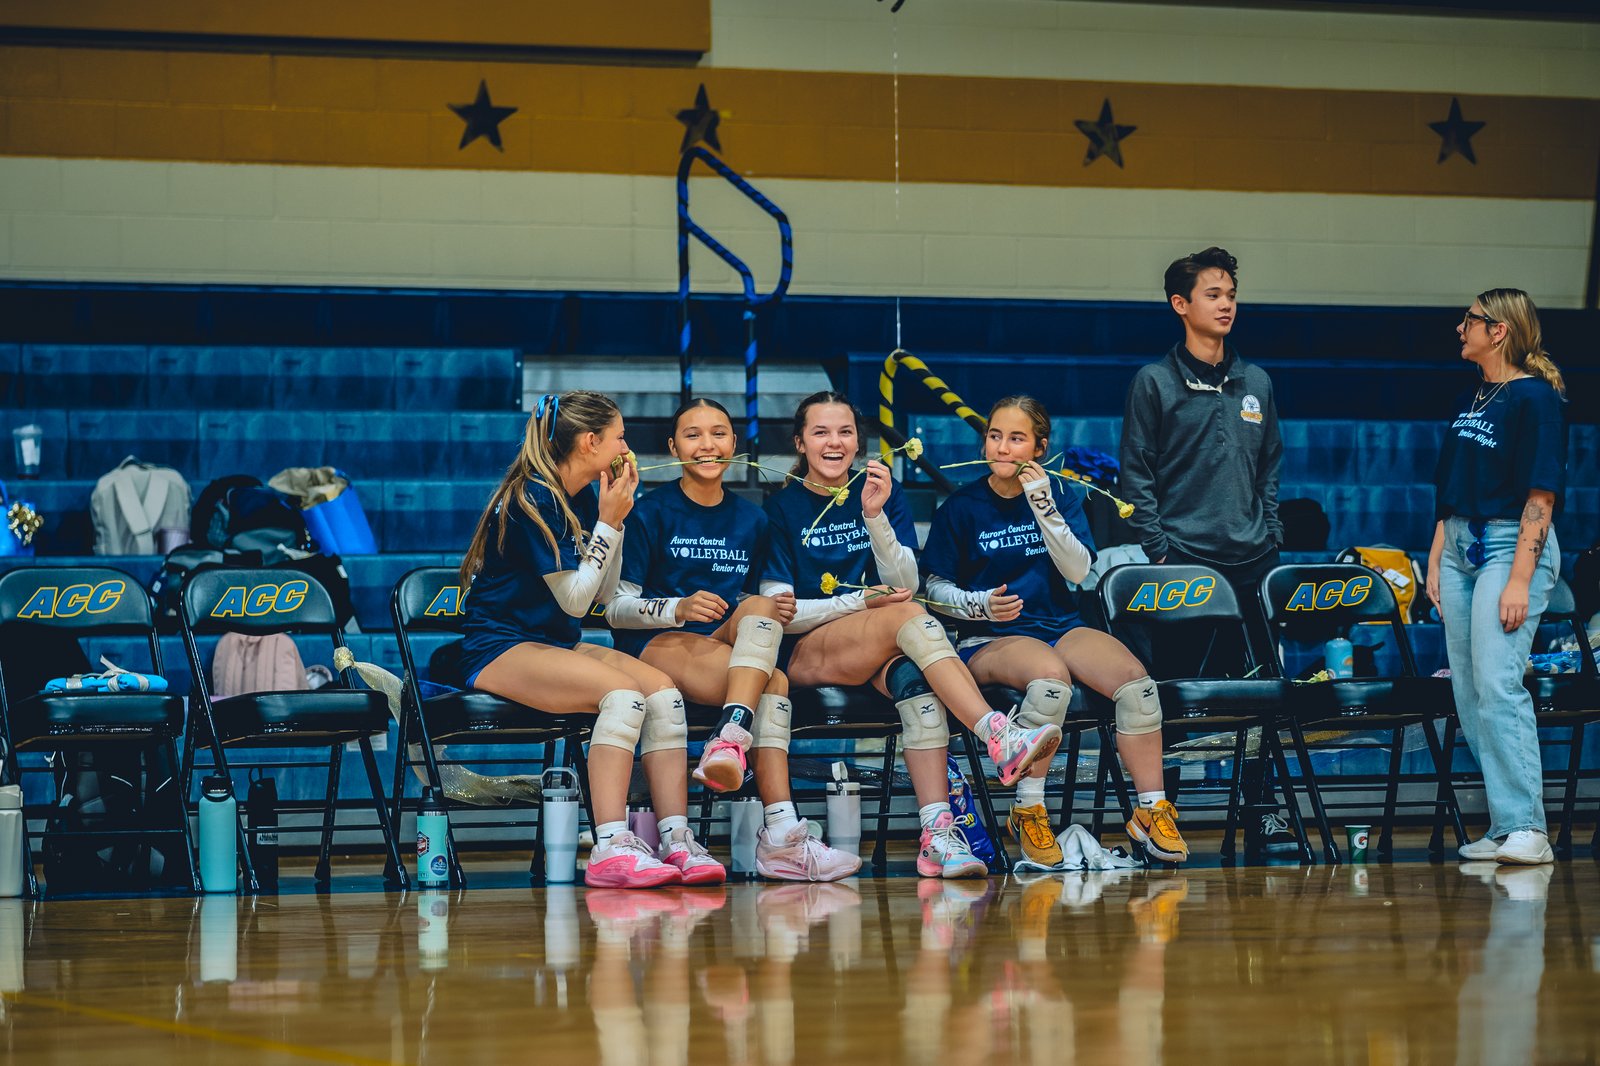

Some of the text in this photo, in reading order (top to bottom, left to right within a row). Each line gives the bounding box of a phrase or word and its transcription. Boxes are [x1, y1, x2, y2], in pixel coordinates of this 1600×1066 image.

[1474, 434, 1497, 448] Night
[829, 519, 857, 532] Central
[979, 521, 1035, 539] Aurora Central
[670, 535, 726, 546] Aurora Central
[802, 526, 869, 548] VOLLEYBA
[670, 547, 749, 561] VOLLEYBALL
[712, 562, 749, 576] Senior Nig
[17, 580, 126, 618] ACC
[210, 580, 309, 617] ACC
[1127, 575, 1216, 611] ACC
[1285, 575, 1373, 611] ACC
[1353, 832, 1369, 850] G
